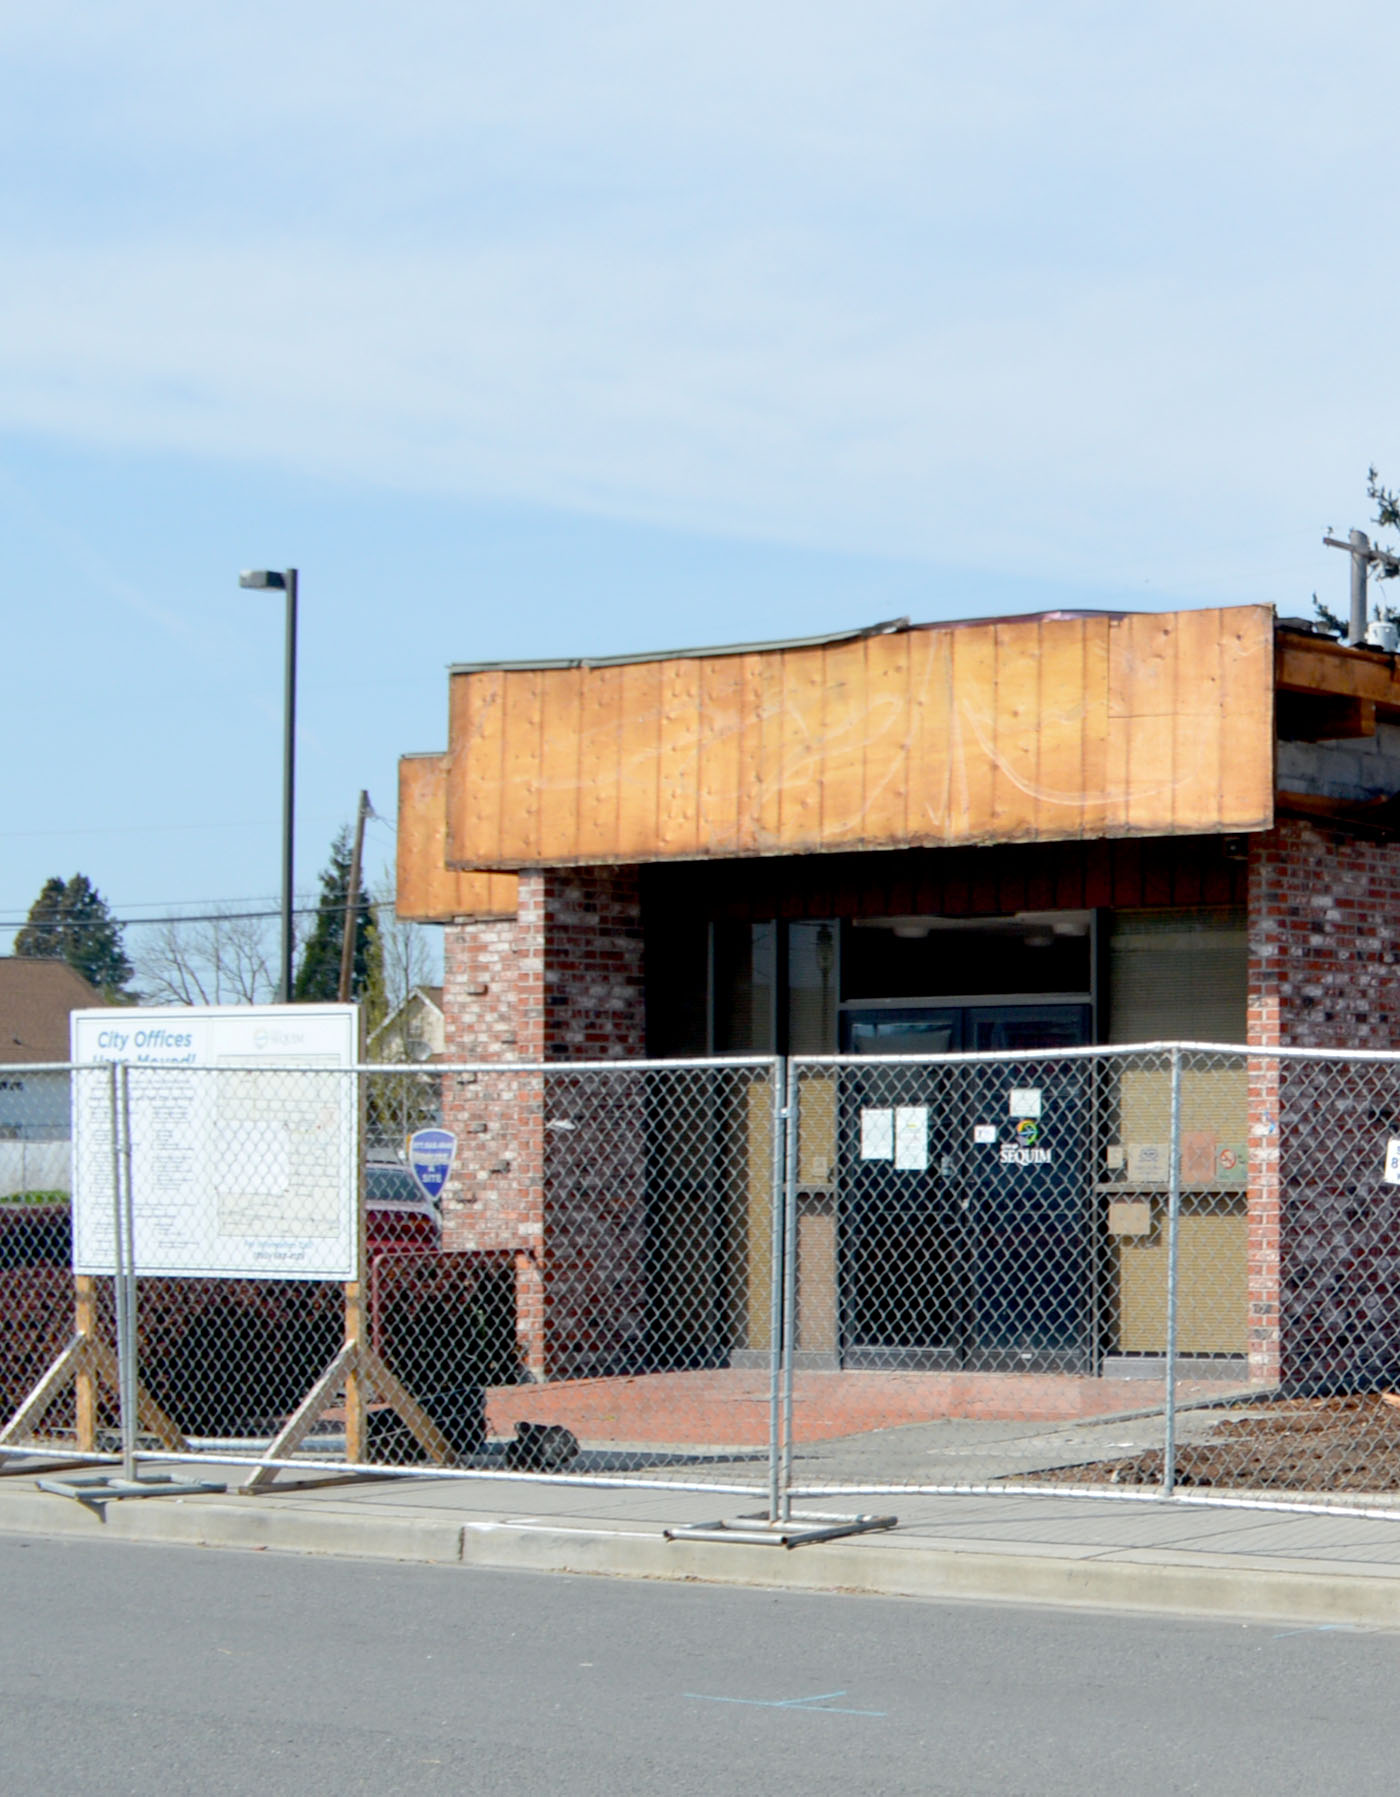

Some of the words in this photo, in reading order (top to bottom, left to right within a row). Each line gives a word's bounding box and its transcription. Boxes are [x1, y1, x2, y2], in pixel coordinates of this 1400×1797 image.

[97, 1030, 129, 1052] City
[134, 1029, 193, 1048] Offices
[1000, 1148, 1052, 1166] SEQUIM
